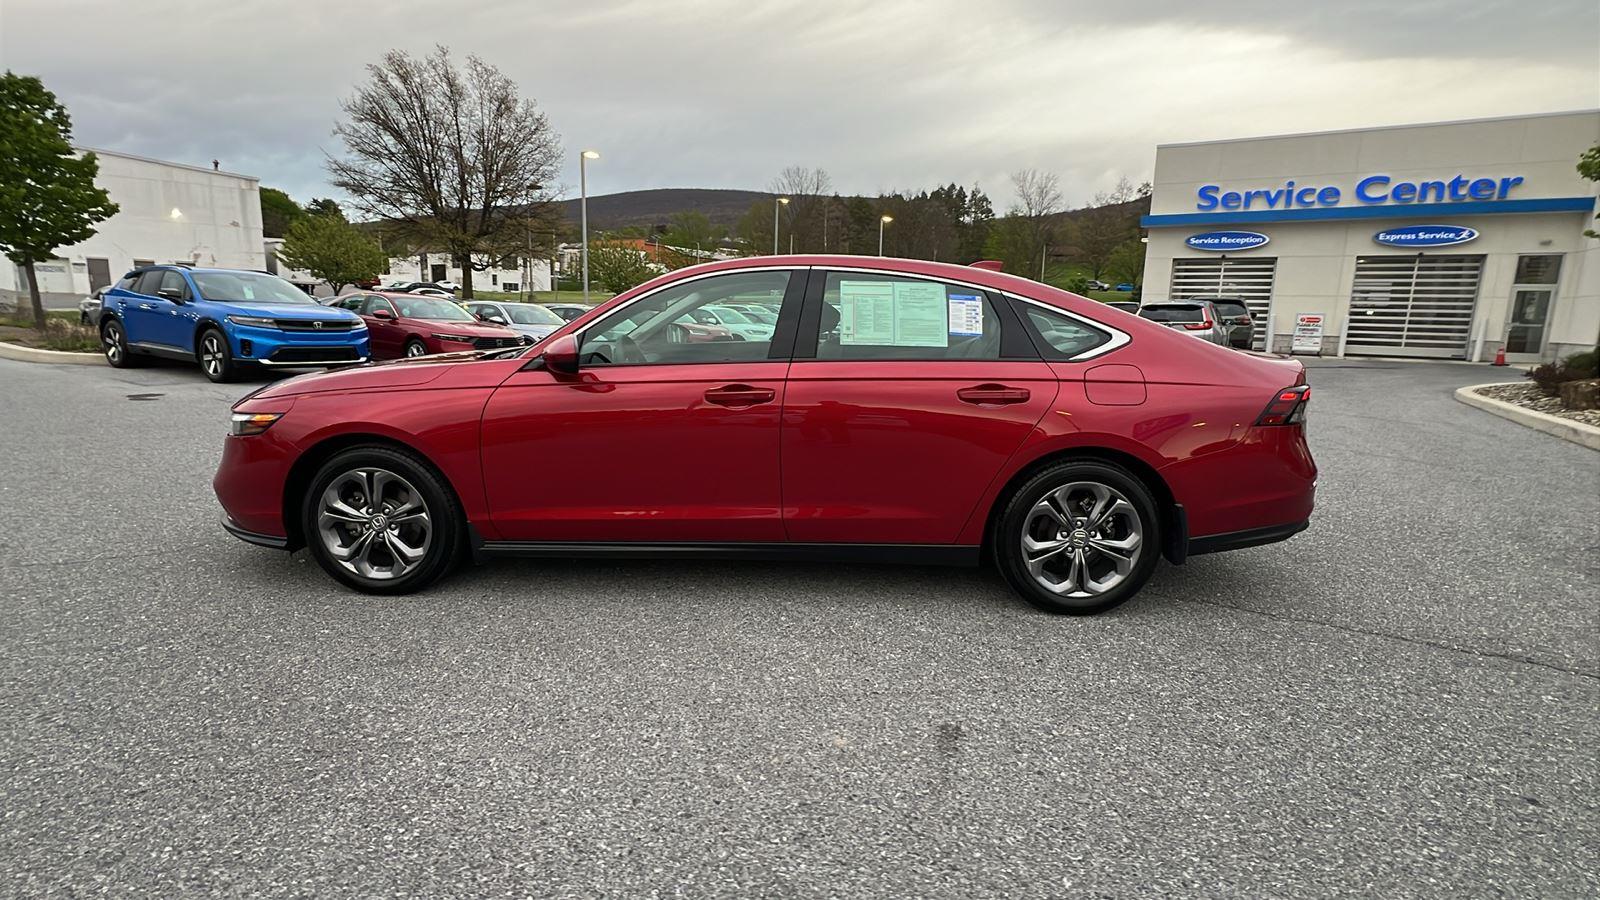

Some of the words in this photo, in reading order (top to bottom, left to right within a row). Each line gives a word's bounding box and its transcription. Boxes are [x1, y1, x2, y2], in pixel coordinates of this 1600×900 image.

[1197, 180, 1341, 211] Service
[1355, 174, 1524, 204] Center
[1189, 237, 1220, 245] Service
[1221, 236, 1264, 245] Reception
[1378, 232, 1416, 241] Express
[1417, 231, 1456, 239] Service
